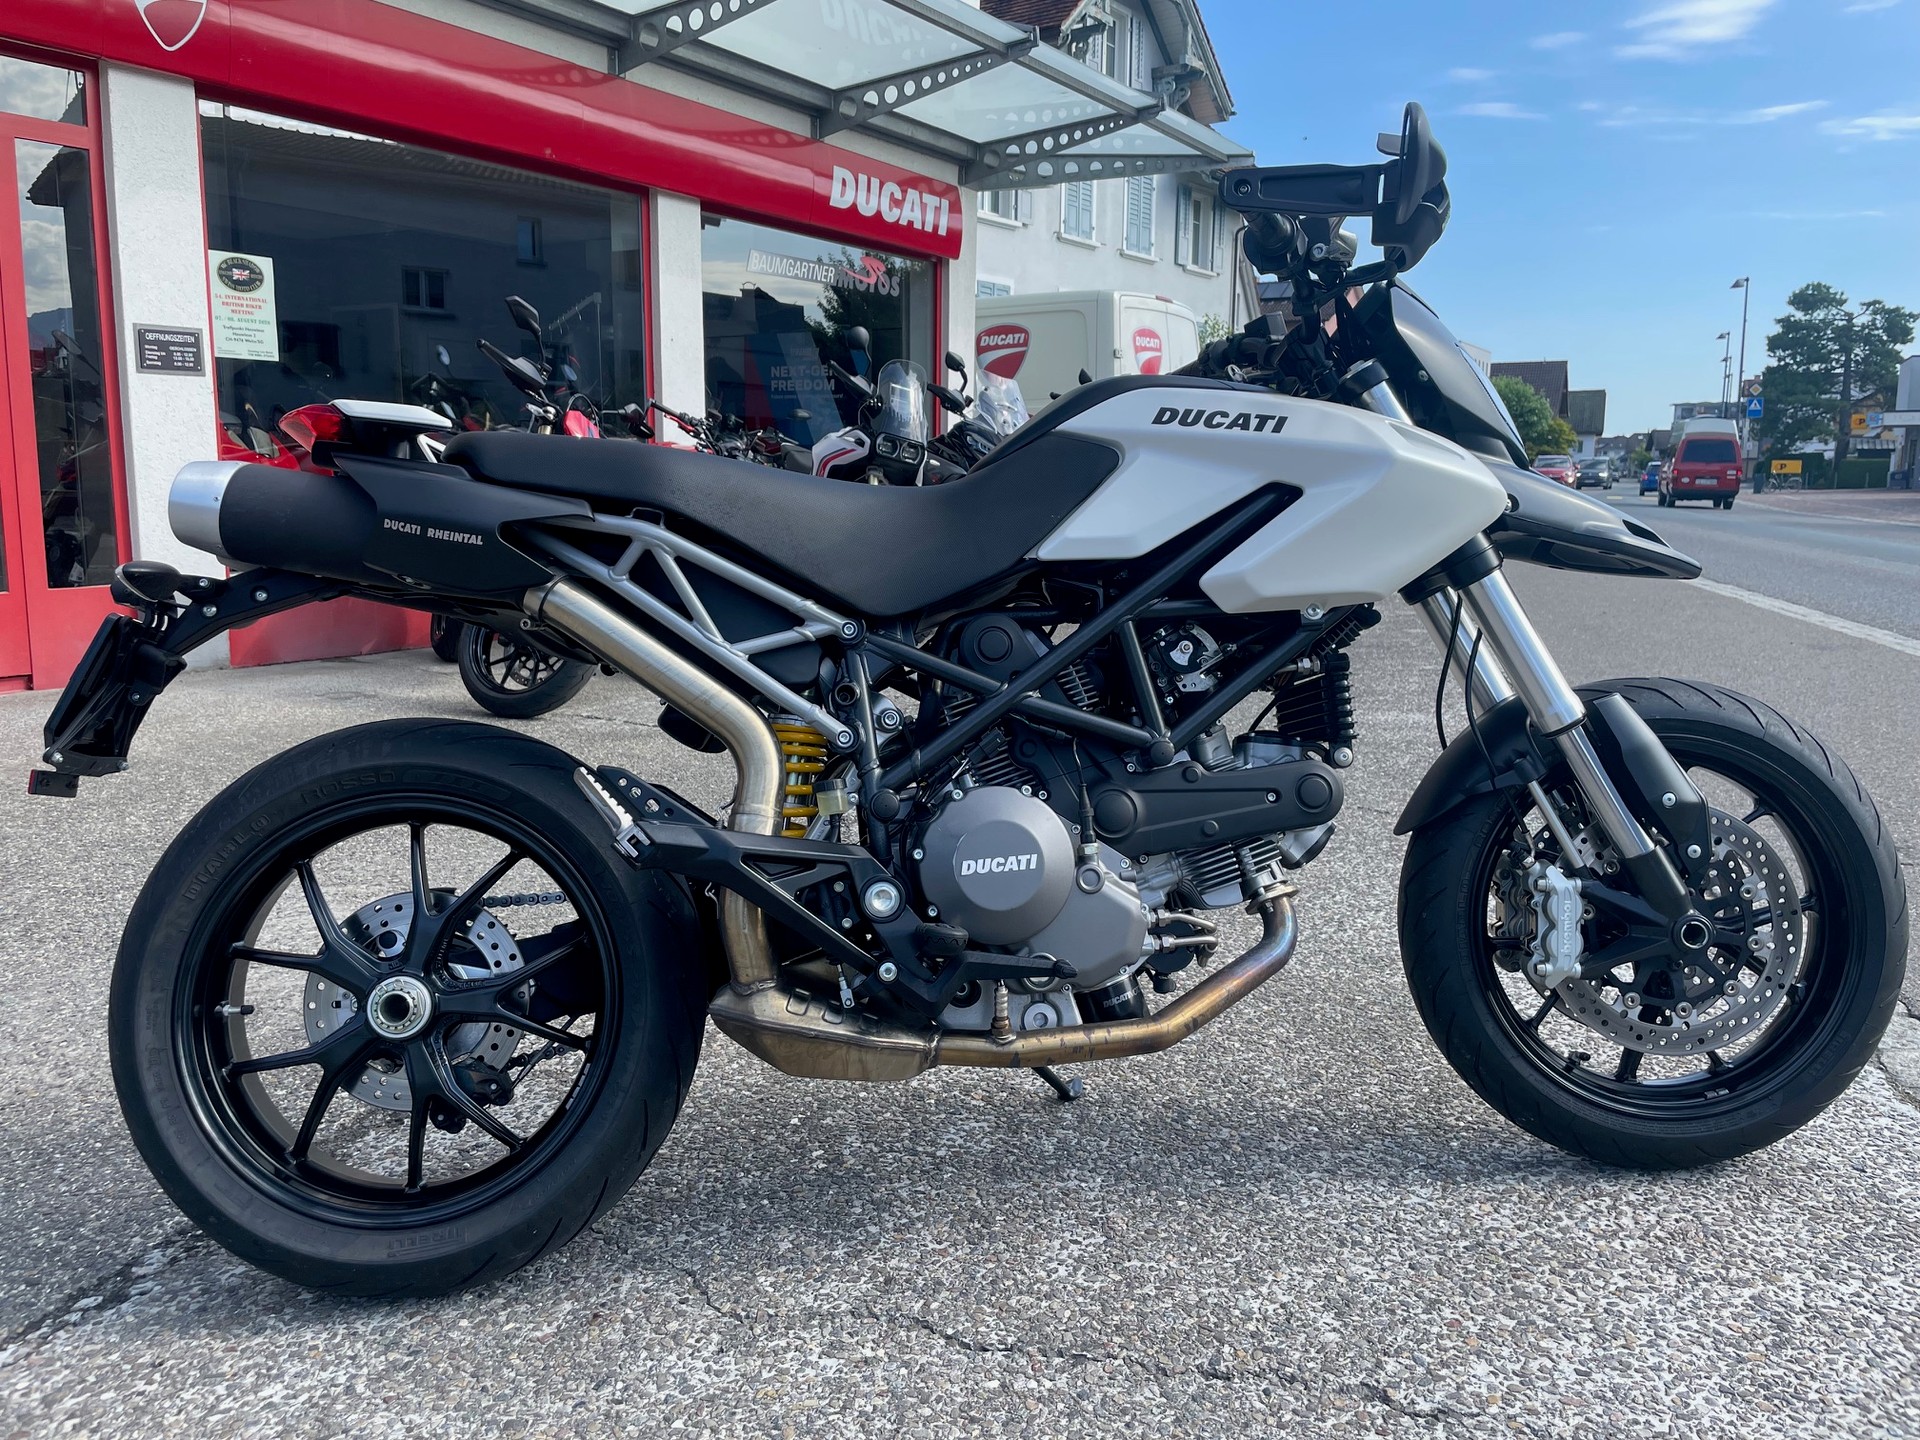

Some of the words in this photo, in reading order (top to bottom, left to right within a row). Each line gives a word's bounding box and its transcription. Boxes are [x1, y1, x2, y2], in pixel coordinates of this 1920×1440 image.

[829, 165, 950, 237] DUCATI
[750, 252, 836, 284] BAUMGARTNER
[225, 294, 267, 303] INTERNATIONAL
[145, 332, 195, 343] OEFFNUNGSZEITEN
[980, 333, 1025, 347] DUCATI
[1135, 335, 1160, 348] DUCATI
[771, 378, 835, 392] FREEDOM
[1151, 407, 1289, 434] DUCATI
[383, 518, 421, 535] DUCATI
[427, 527, 484, 545] RHEINTAL
[301, 769, 397, 804] ROSSO
[961, 853, 1038, 876] DUCATI
[1560, 903, 1573, 953] brembo
[1103, 990, 1134, 1008] DUCATI
